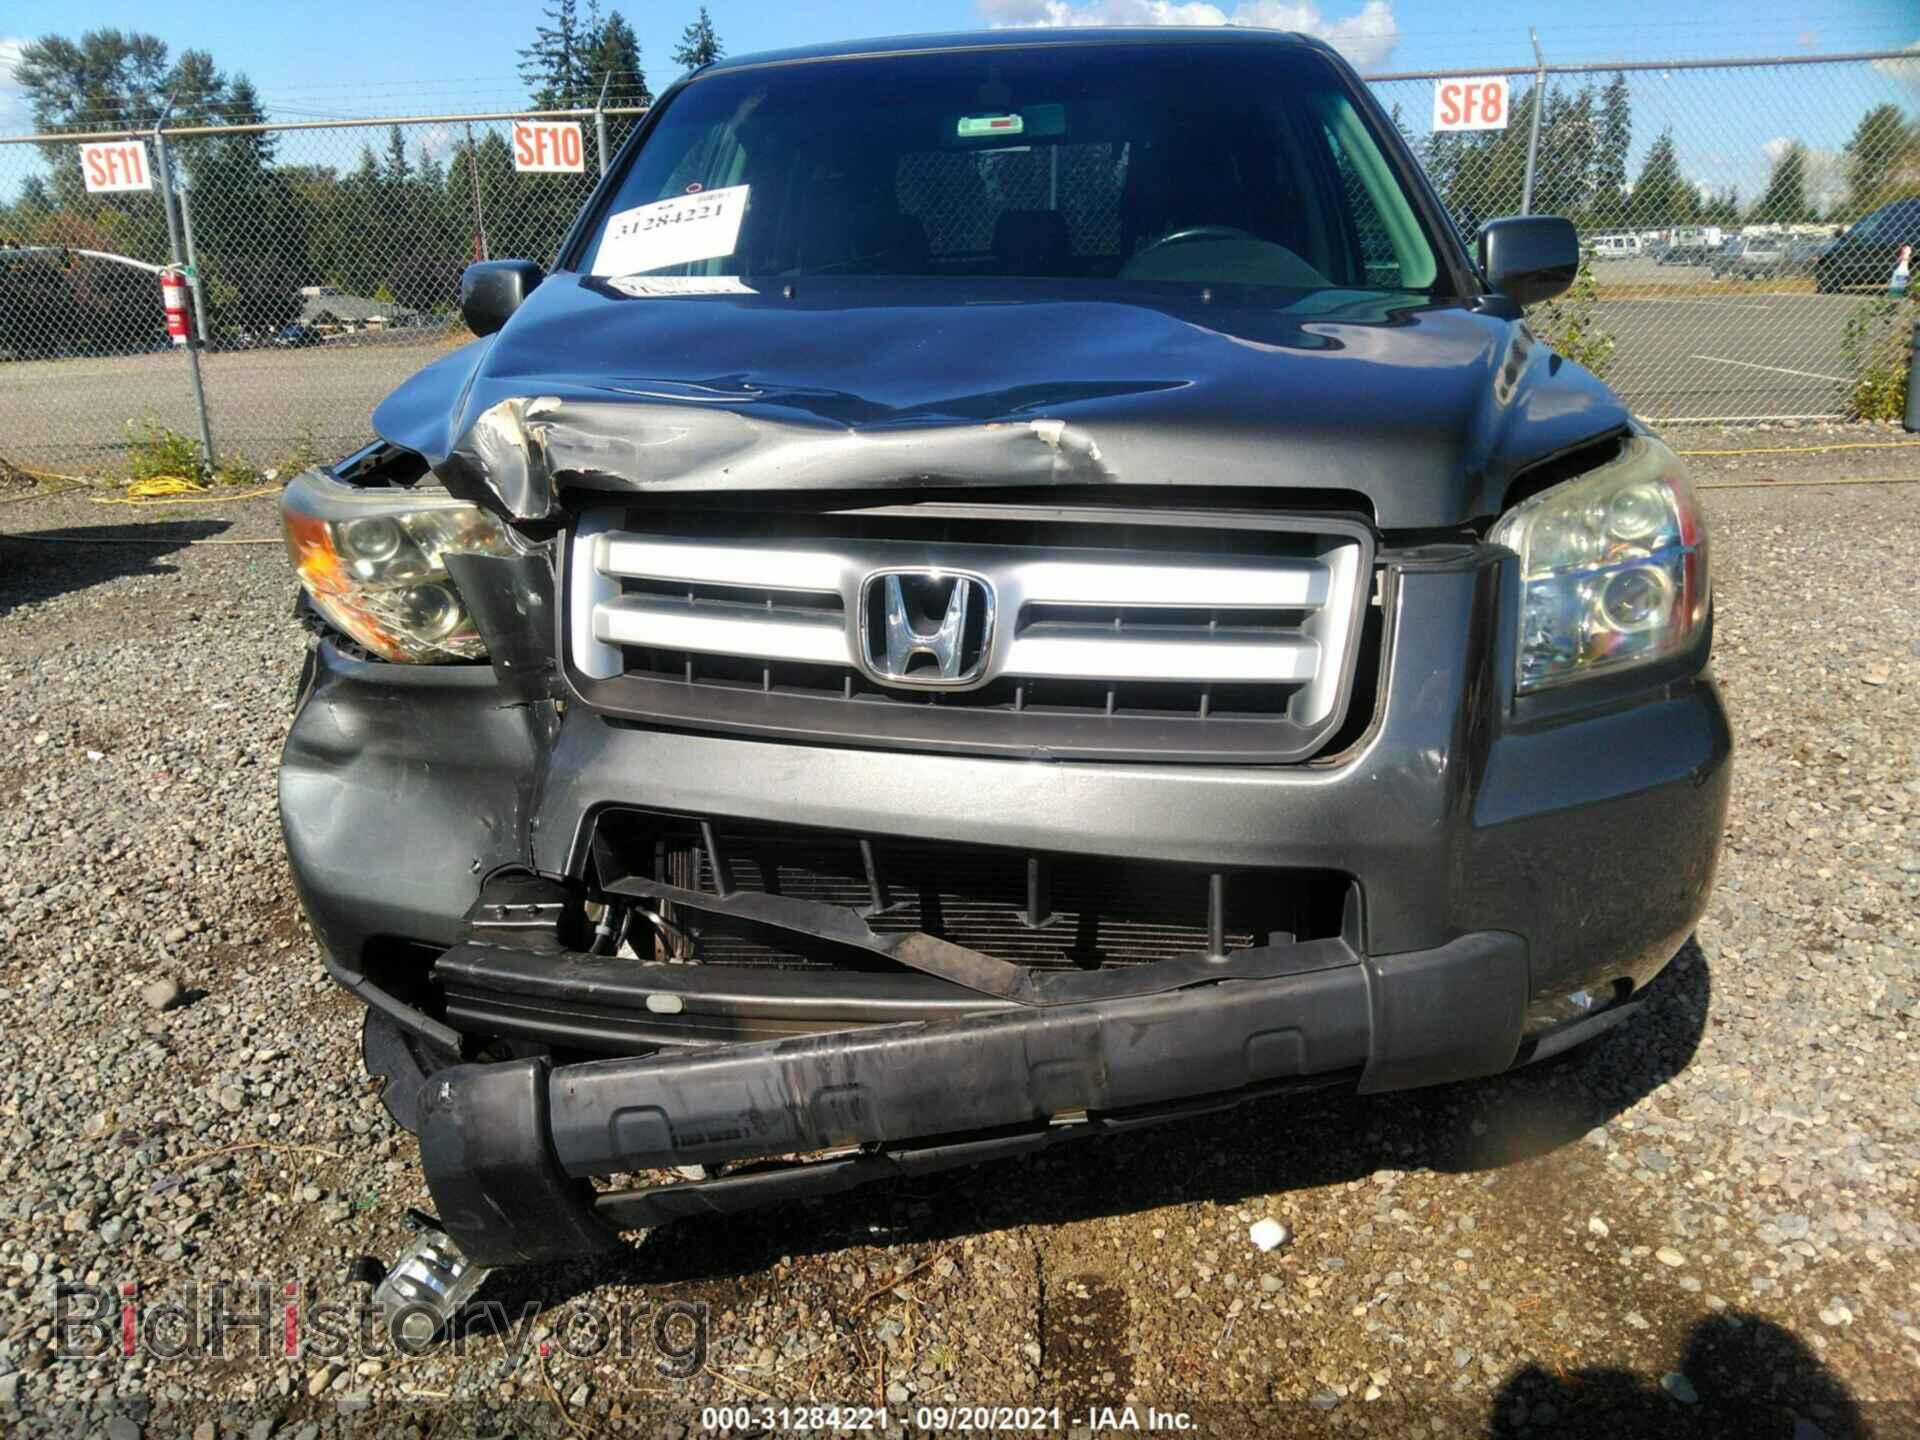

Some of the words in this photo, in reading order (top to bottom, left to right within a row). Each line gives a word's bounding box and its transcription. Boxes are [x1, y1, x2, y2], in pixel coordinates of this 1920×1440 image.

[1441, 83, 1503, 125] SF8
[516, 127, 579, 167] SF10
[86, 148, 144, 186] SF11
[614, 203, 724, 239] 31284221
